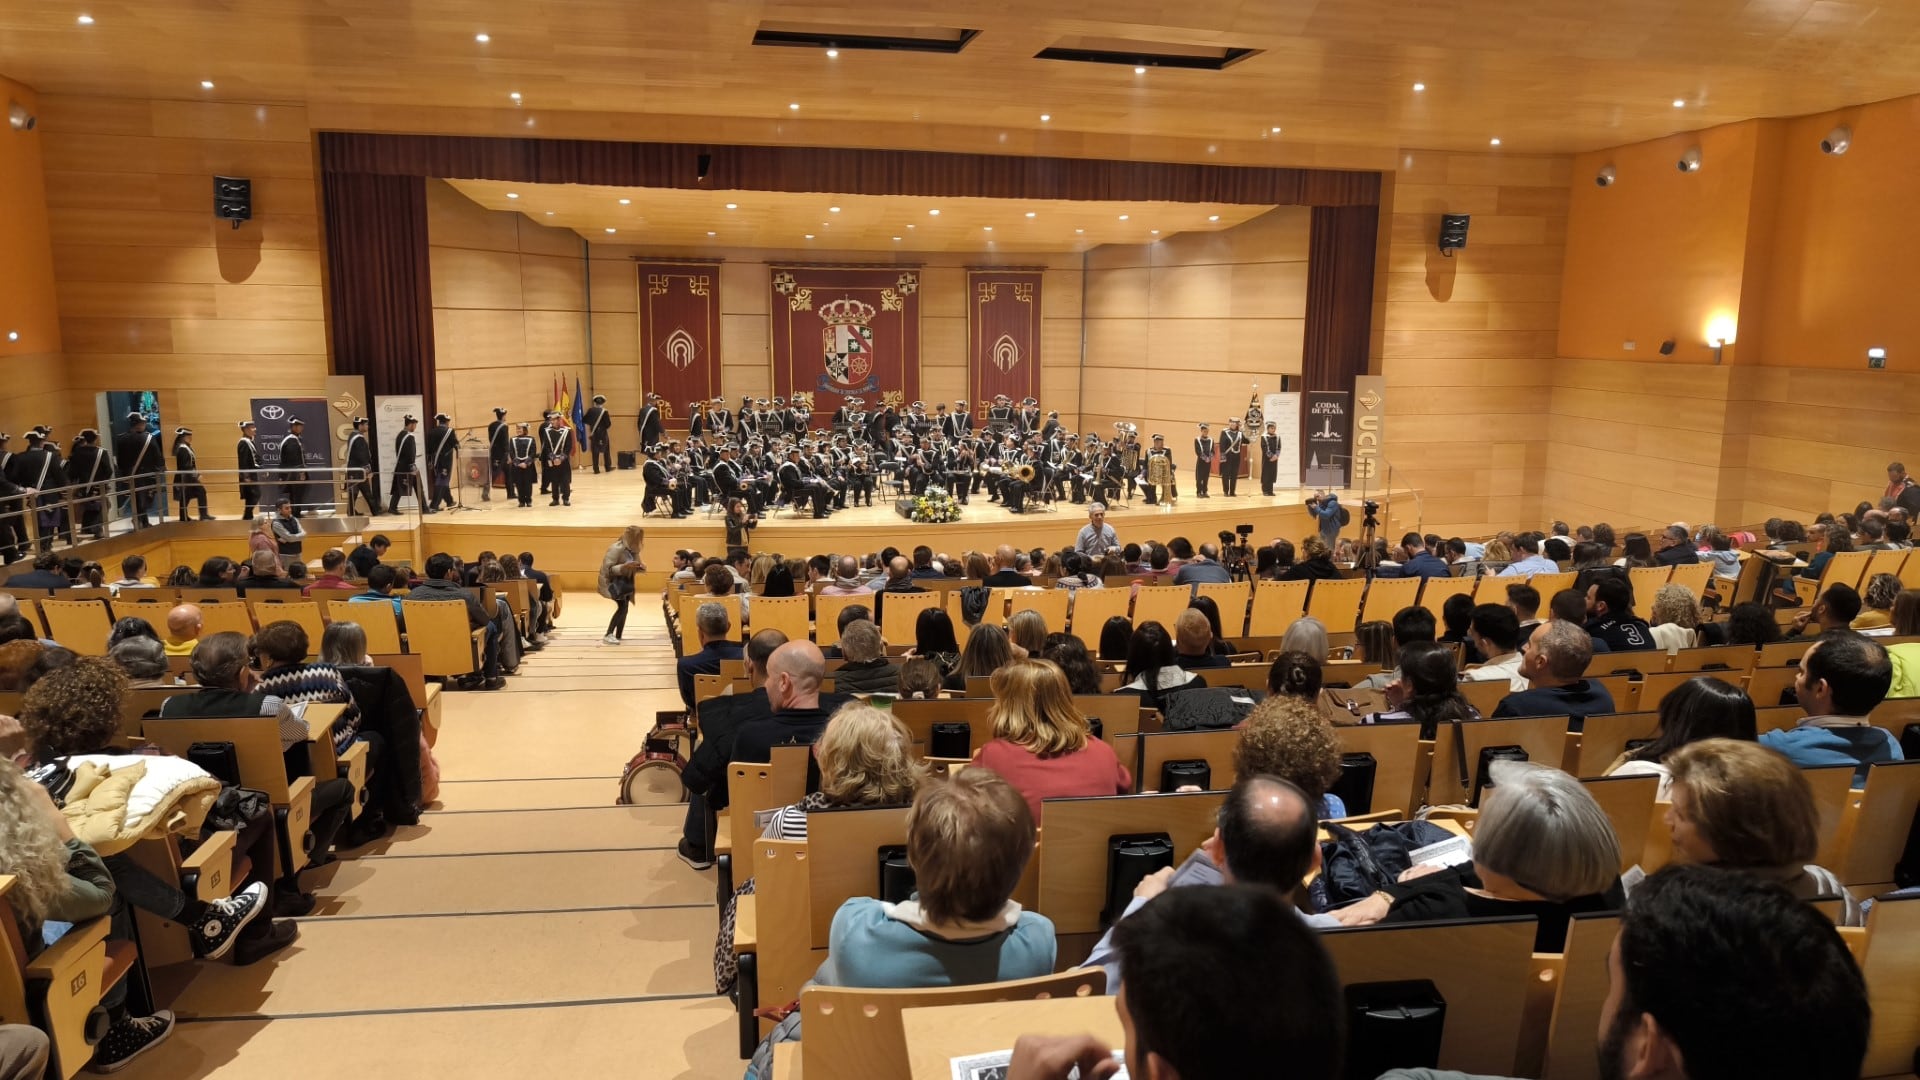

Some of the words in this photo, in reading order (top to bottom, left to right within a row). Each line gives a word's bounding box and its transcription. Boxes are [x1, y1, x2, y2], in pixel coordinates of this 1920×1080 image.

[1315, 401, 1341, 409] CODAL
[1620, 623, 1645, 645] 3
[73, 973, 85, 992] 16
